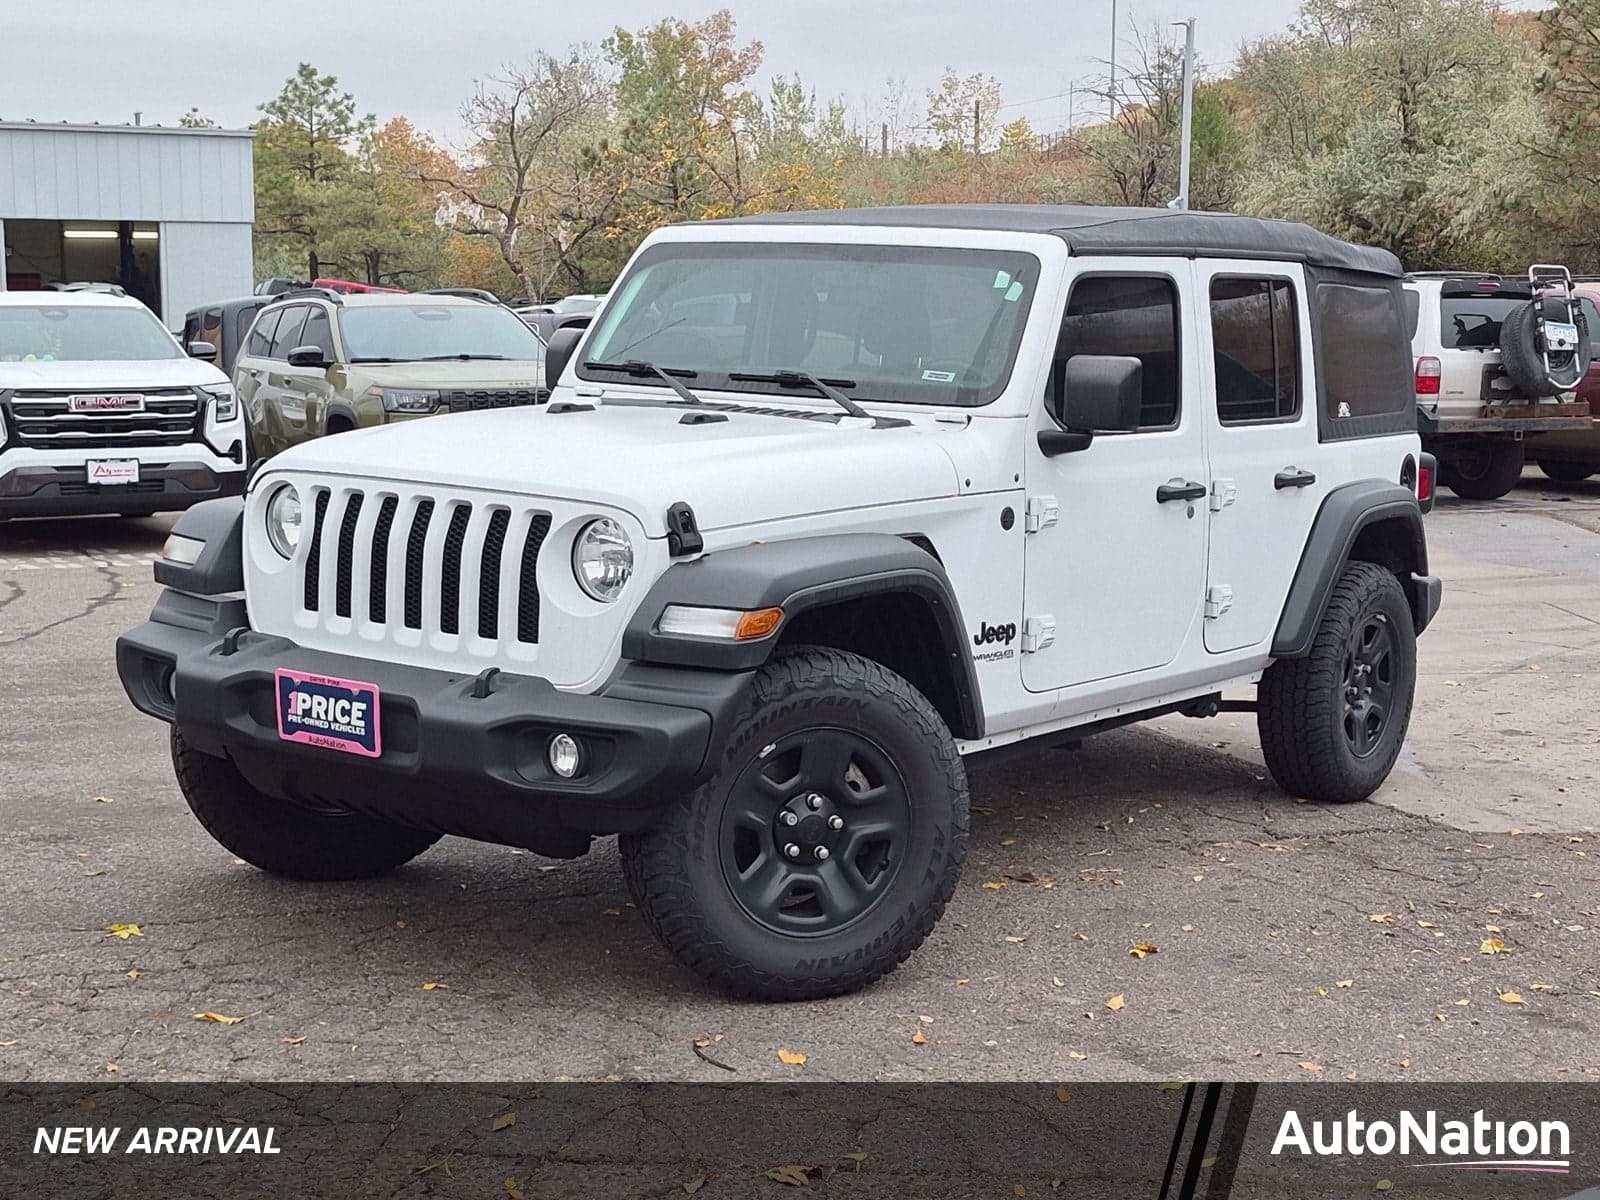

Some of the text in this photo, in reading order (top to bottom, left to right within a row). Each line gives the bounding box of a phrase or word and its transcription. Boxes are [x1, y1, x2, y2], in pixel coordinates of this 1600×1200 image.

[75, 396, 142, 410] GMC
[973, 621, 1016, 646] Jeep
[972, 649, 1014, 661] WRANGLER
[287, 714, 366, 736] PRE-OWNED VEHICLES
[724, 694, 868, 762] MOUNTAIN
[308, 735, 347, 750] AutoNation
